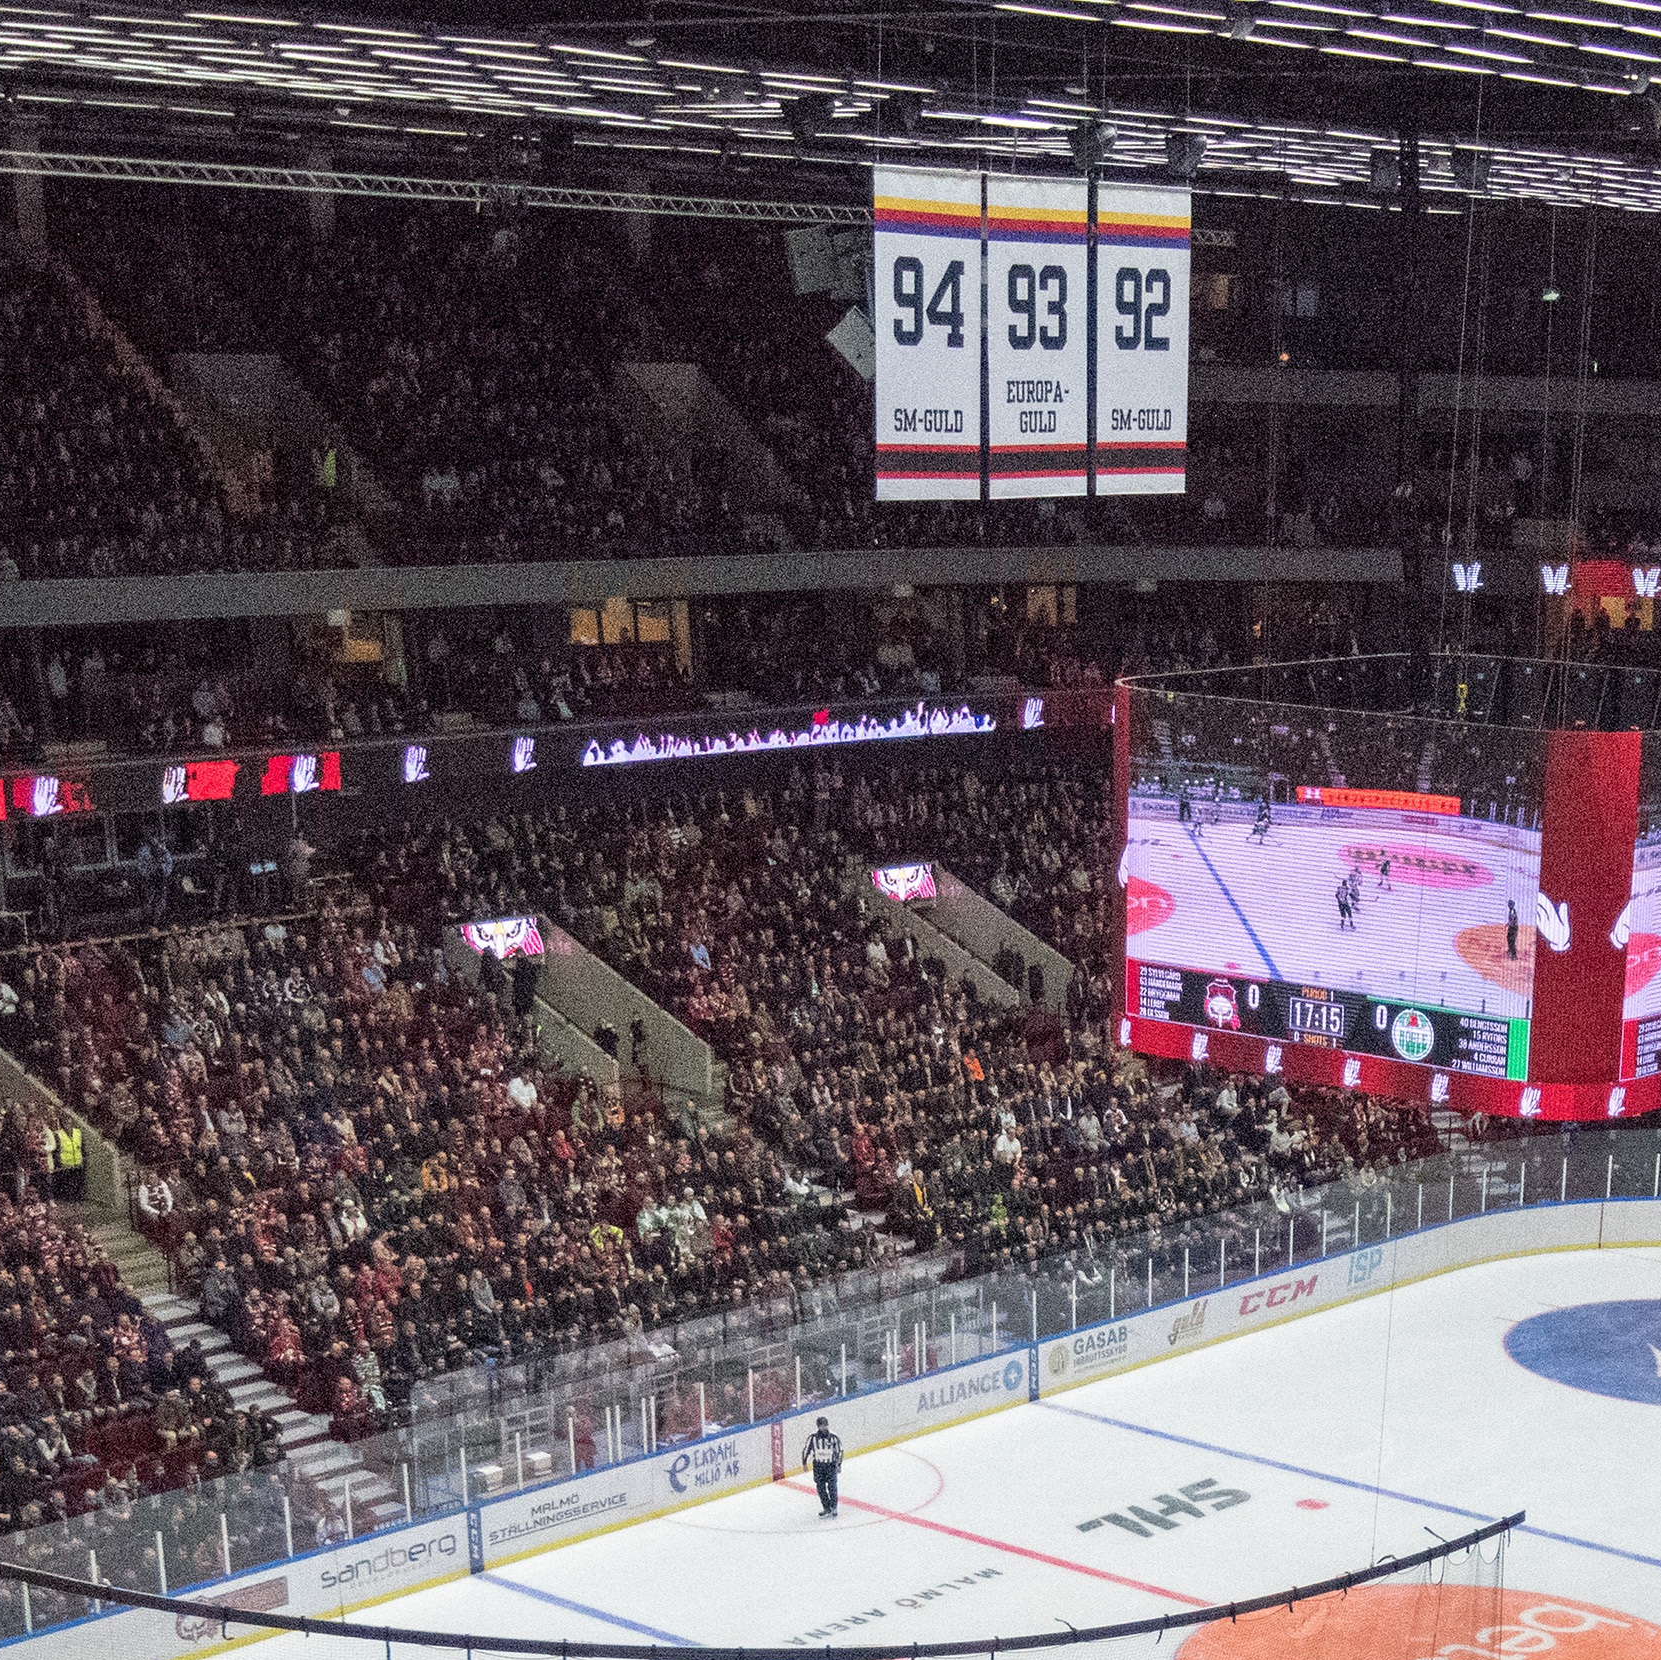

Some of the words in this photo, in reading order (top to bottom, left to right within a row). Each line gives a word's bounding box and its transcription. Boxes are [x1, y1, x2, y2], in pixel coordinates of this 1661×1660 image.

[893, 256, 966, 349] 94
[1008, 264, 1068, 350] 93
[1116, 267, 1172, 351] 92
[1006, 380, 1070, 404] EUROPA-
[893, 409, 965, 434] SM-GULD
[1019, 410, 1057, 433] GULD
[1111, 408, 1172, 432] SM-GULD
[1248, 984, 1259, 1010] 0
[1294, 1001, 1341, 1032] 17:15
[1375, 1005, 1388, 1030] 0
[1239, 1276, 1319, 1316] CCM
[1073, 1325, 1128, 1355] GASAB
[917, 1369, 1001, 1413] ALLIANCE
[531, 1493, 581, 1517] MALMÖ
[1076, 1477, 1251, 1539] SHL
[894, 1567, 1004, 1610] MALMÖ
[783, 1607, 886, 1647] ARENA
